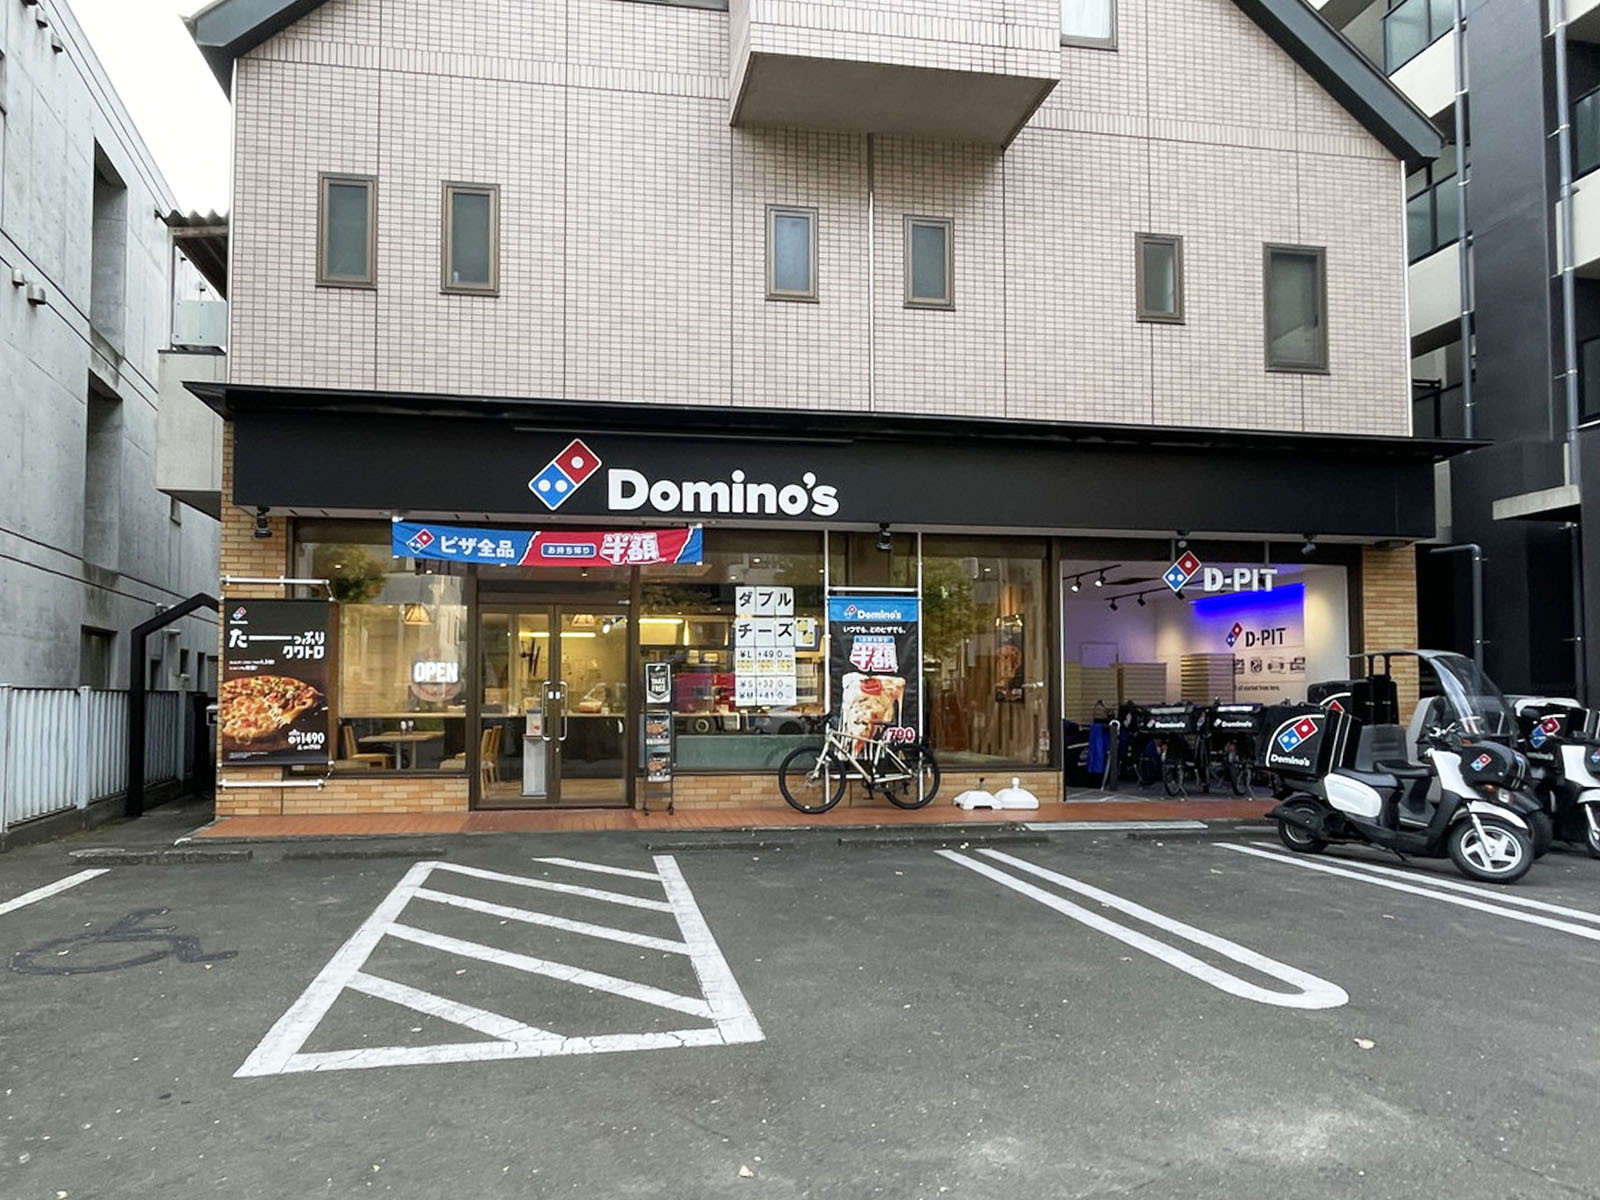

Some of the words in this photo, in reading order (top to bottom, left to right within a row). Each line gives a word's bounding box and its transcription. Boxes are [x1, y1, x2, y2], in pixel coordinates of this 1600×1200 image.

[608, 468, 839, 516] Domino's
[441, 535, 515, 558] ピザ全品
[601, 533, 659, 563] 半額
[1204, 567, 1278, 592] D-PIT
[739, 591, 791, 608] ダブル
[857, 610, 902, 620] Domino's
[738, 622, 793, 639] チーズ
[282, 645, 325, 659] クワトロ
[850, 643, 898, 672] 半額
[414, 661, 459, 683] OPEN
[1270, 753, 1311, 767] Domino's
